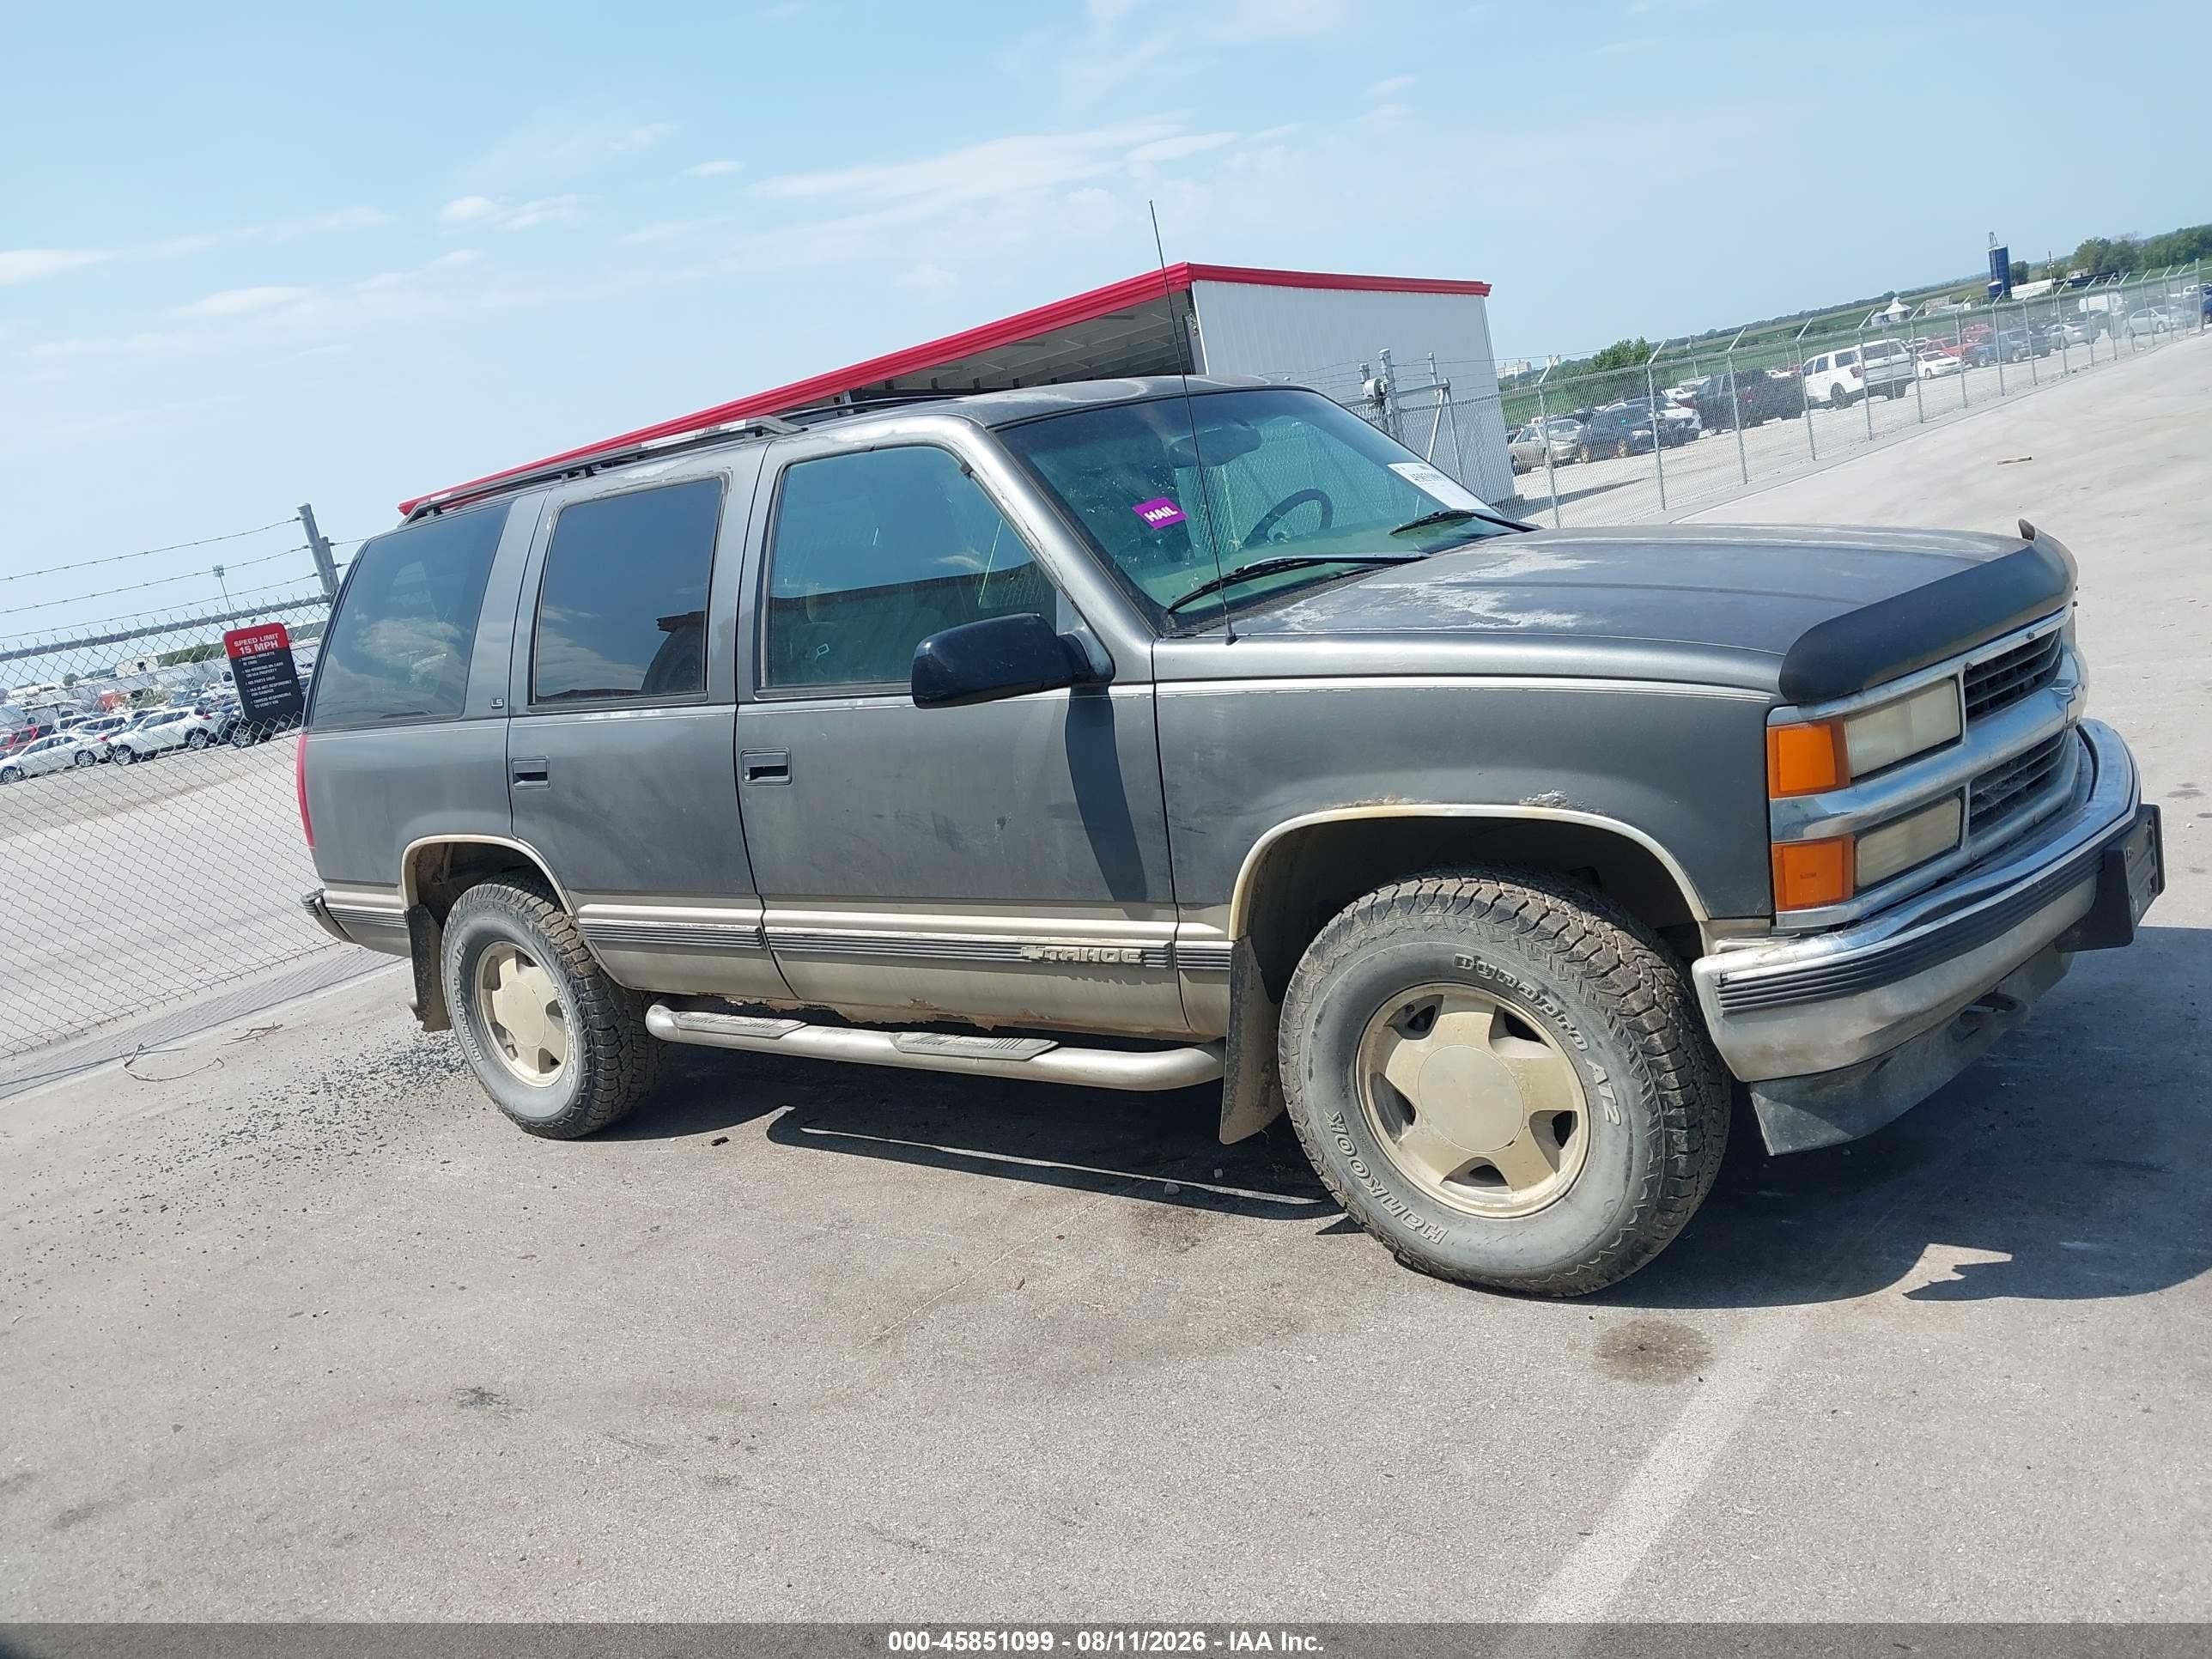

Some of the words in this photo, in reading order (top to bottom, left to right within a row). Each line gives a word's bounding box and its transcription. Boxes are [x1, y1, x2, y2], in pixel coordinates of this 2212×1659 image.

[1144, 506, 1179, 523] HAIL
[234, 637, 258, 647] SPEED
[259, 632, 279, 642] LIMIT
[239, 645, 252, 654] 15
[254, 639, 279, 652] MPH
[1044, 945, 1143, 964] TAHOE
[1453, 953, 1589, 1051] Dynapro
[1585, 1058, 1621, 1126] AT2
